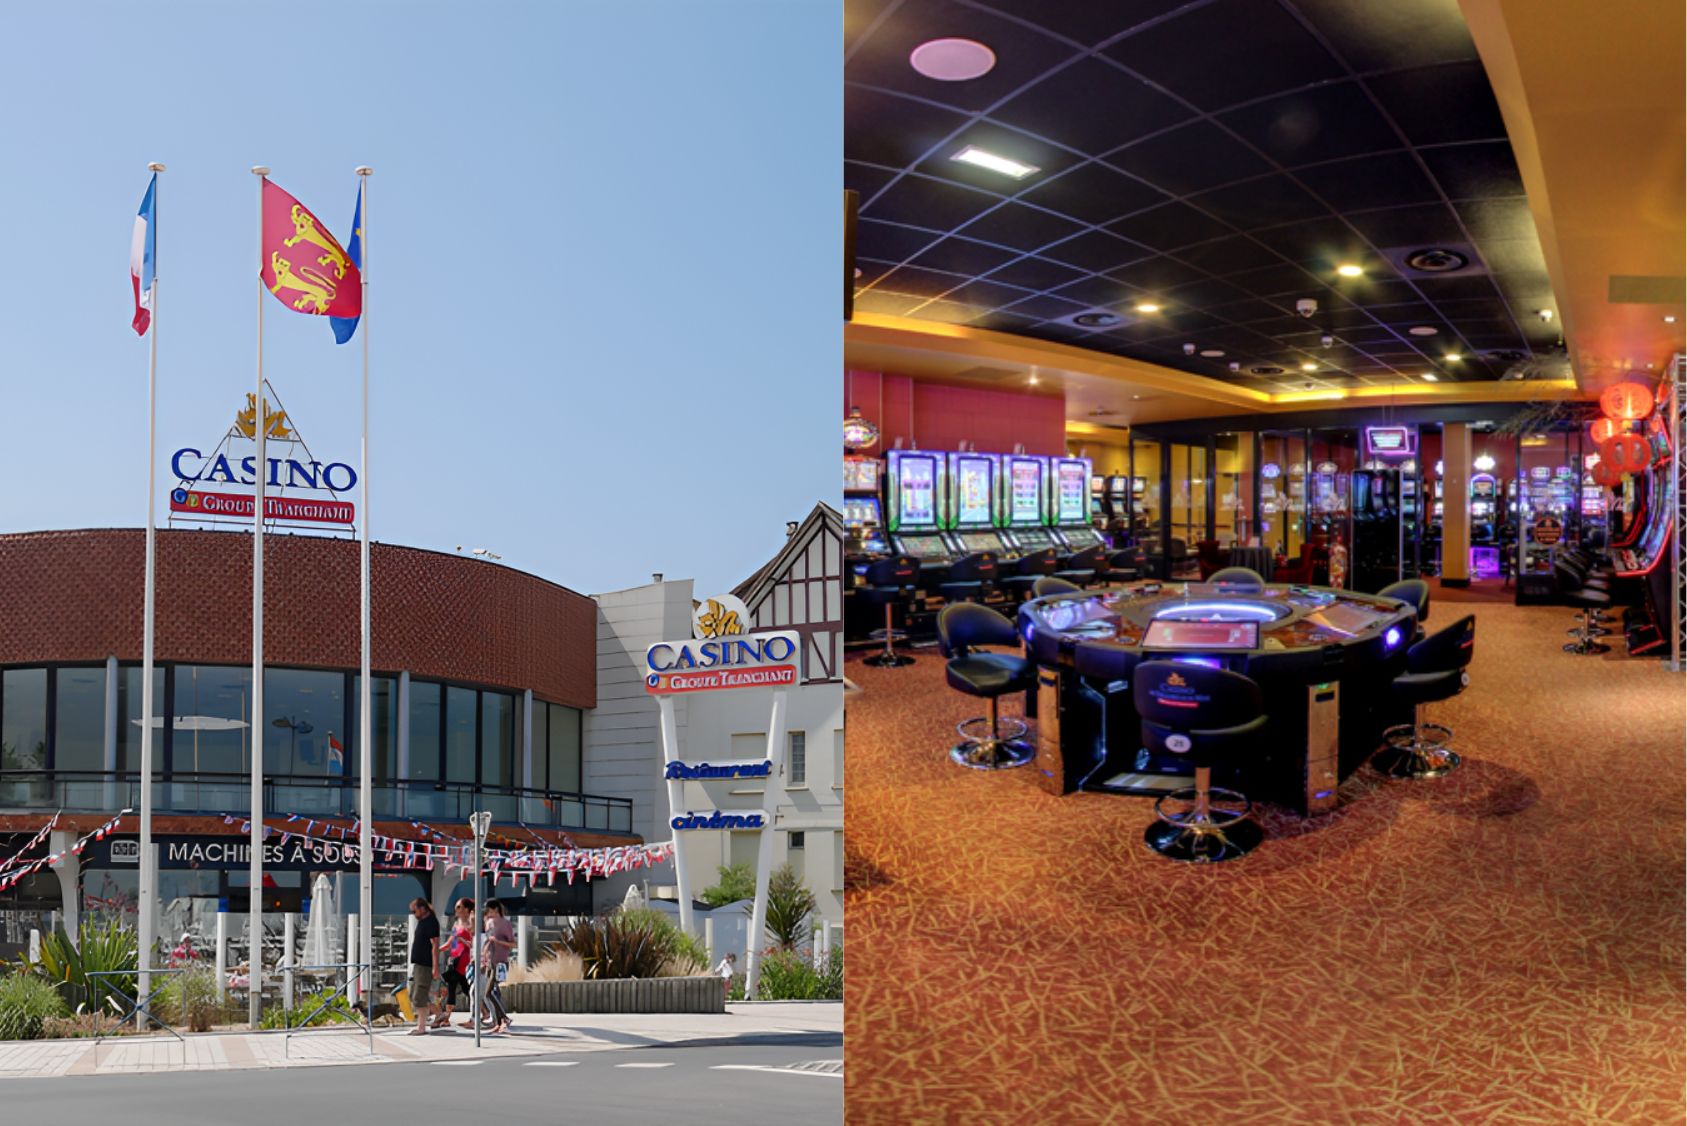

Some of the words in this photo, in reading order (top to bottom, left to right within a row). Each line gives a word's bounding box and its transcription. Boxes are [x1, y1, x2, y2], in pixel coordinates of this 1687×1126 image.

[171, 448, 357, 492] CASINO
[202, 495, 255, 513] GROUP
[647, 636, 796, 672] CASINO
